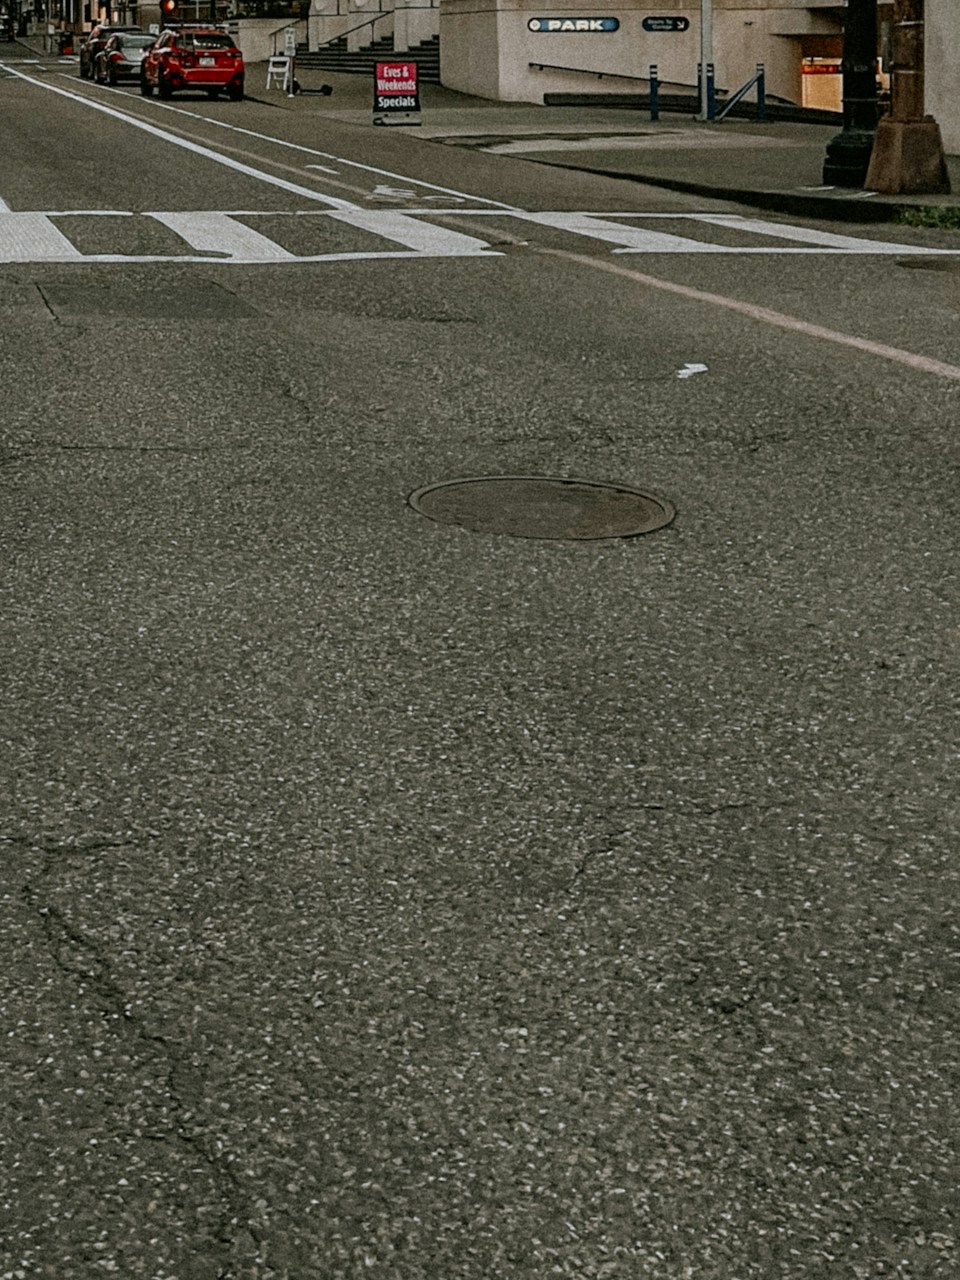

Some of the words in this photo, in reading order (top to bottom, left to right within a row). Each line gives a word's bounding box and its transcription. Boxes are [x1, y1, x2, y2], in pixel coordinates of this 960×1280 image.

[548, 19, 605, 31] PARK
[383, 66, 401, 77] Eves
[402, 66, 409, 77] &
[376, 79, 416, 90] Weekends
[378, 96, 416, 108] Specials
